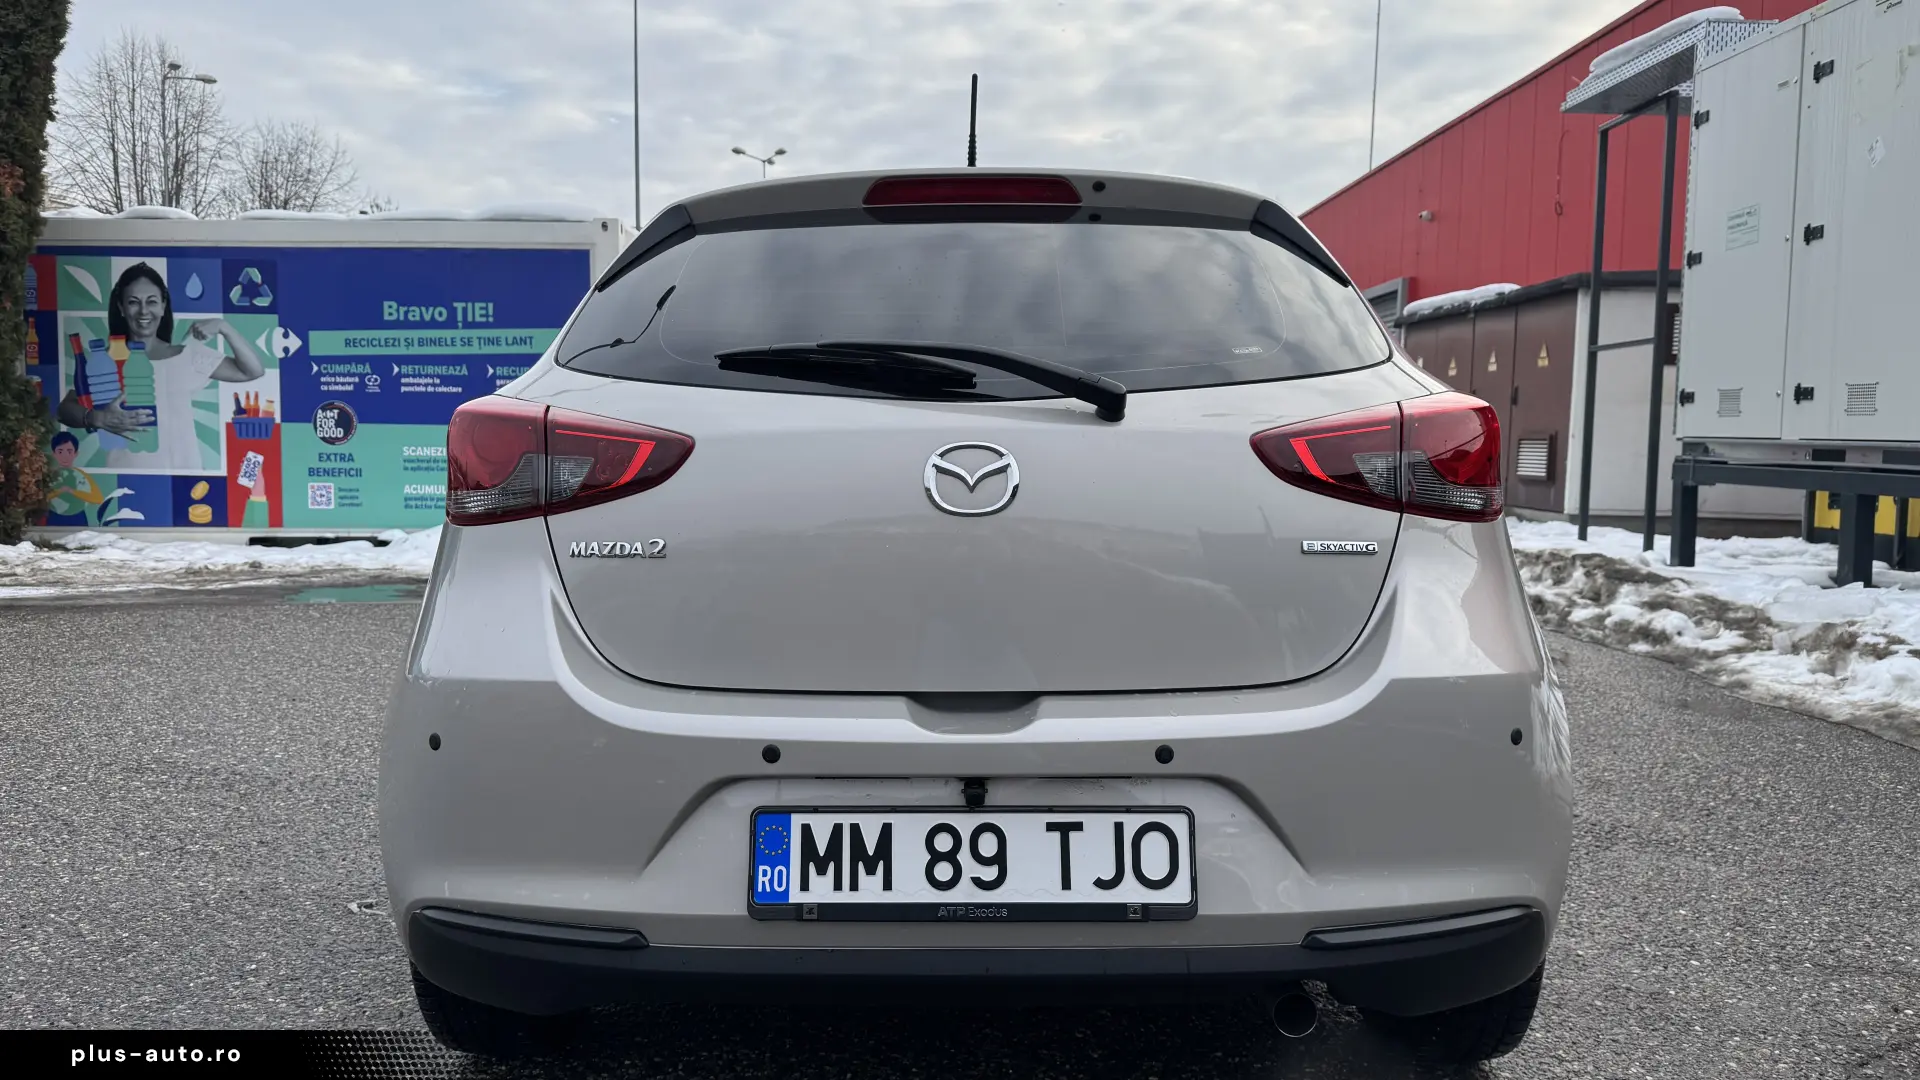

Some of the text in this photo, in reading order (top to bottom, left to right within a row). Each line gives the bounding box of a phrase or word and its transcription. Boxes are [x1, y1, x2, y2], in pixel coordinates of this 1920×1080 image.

[383, 301, 494, 329] Bravo ȚIE!
[344, 336, 533, 351] RECICLEZI ȘI BINELE SE ȚINE LANȚ
[320, 362, 371, 373] CUMPĂRĂ
[401, 364, 468, 375] RETURNEAZĂ
[316, 419, 336, 428] FOR
[316, 428, 344, 438] GOOD
[318, 452, 355, 463] EXTRA
[308, 467, 363, 477] BENEFICII
[800, 821, 1180, 892] MM 89 TJO
[757, 865, 787, 892] RO
[937, 906, 1008, 917] ATP Exodus
